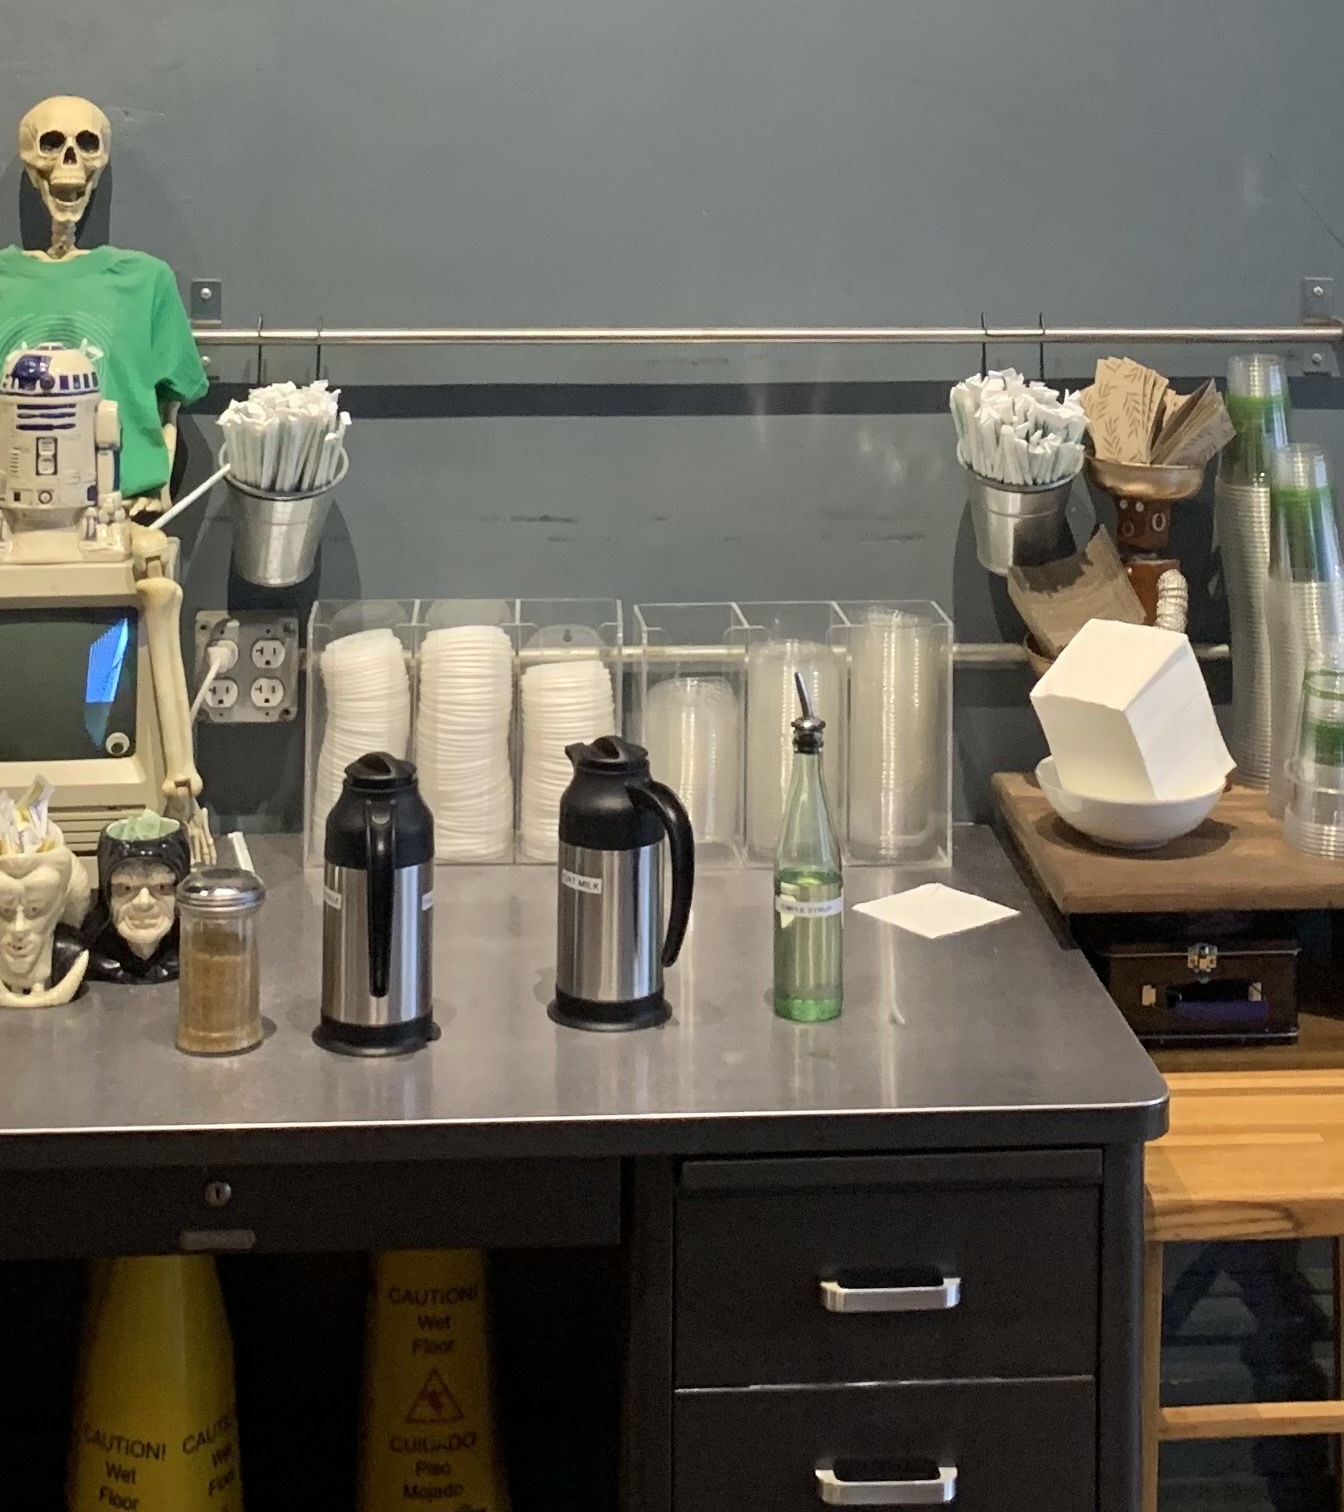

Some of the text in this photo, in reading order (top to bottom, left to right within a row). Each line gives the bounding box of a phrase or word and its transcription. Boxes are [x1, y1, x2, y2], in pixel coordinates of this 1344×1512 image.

[417, 1314, 451, 1330] Wet
[411, 1338, 456, 1355] Floor
[82, 1422, 166, 1462] CAUTION!
[104, 1462, 137, 1485] Wet
[98, 1486, 140, 1511] Floor
